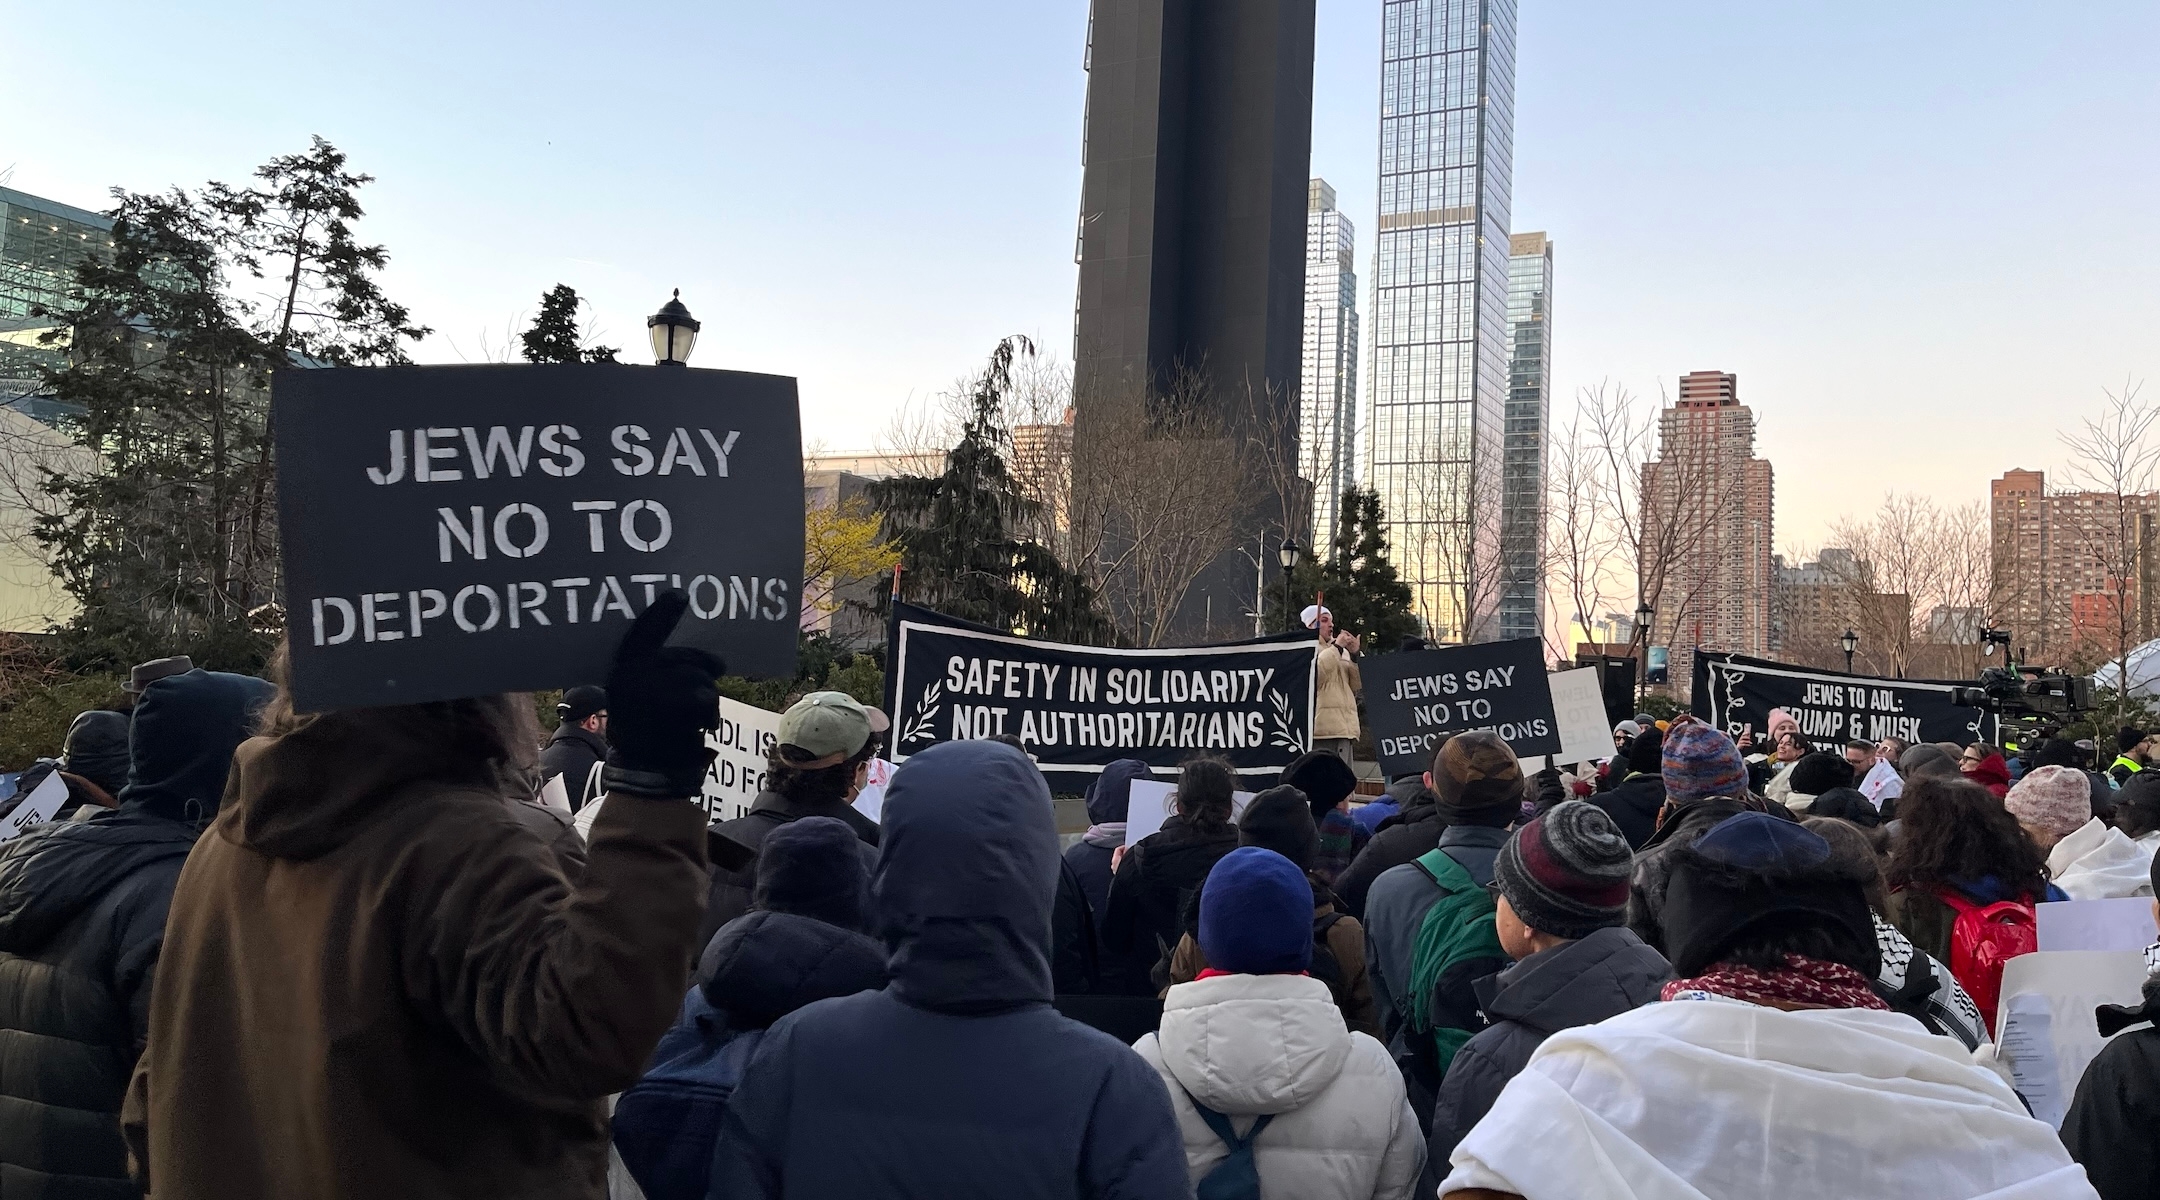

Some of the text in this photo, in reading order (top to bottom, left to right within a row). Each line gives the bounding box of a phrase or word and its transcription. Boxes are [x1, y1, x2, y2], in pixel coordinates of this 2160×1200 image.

[366, 424, 741, 485] JEWS SAY
[437, 499, 672, 563] NO TO
[946, 655, 1275, 705] SAFETY IN SOLIDARITY
[1390, 665, 1515, 701] JEWS SAY
[1802, 683, 1903, 712] JEWS TO ADL:
[952, 703, 1265, 748] NOT AUTHORITARIANS
[1413, 698, 1491, 727] NO TO
[1849, 713, 1864, 740] &
[1869, 715, 1922, 744] MUSK
[755, 729, 777, 759] IS
